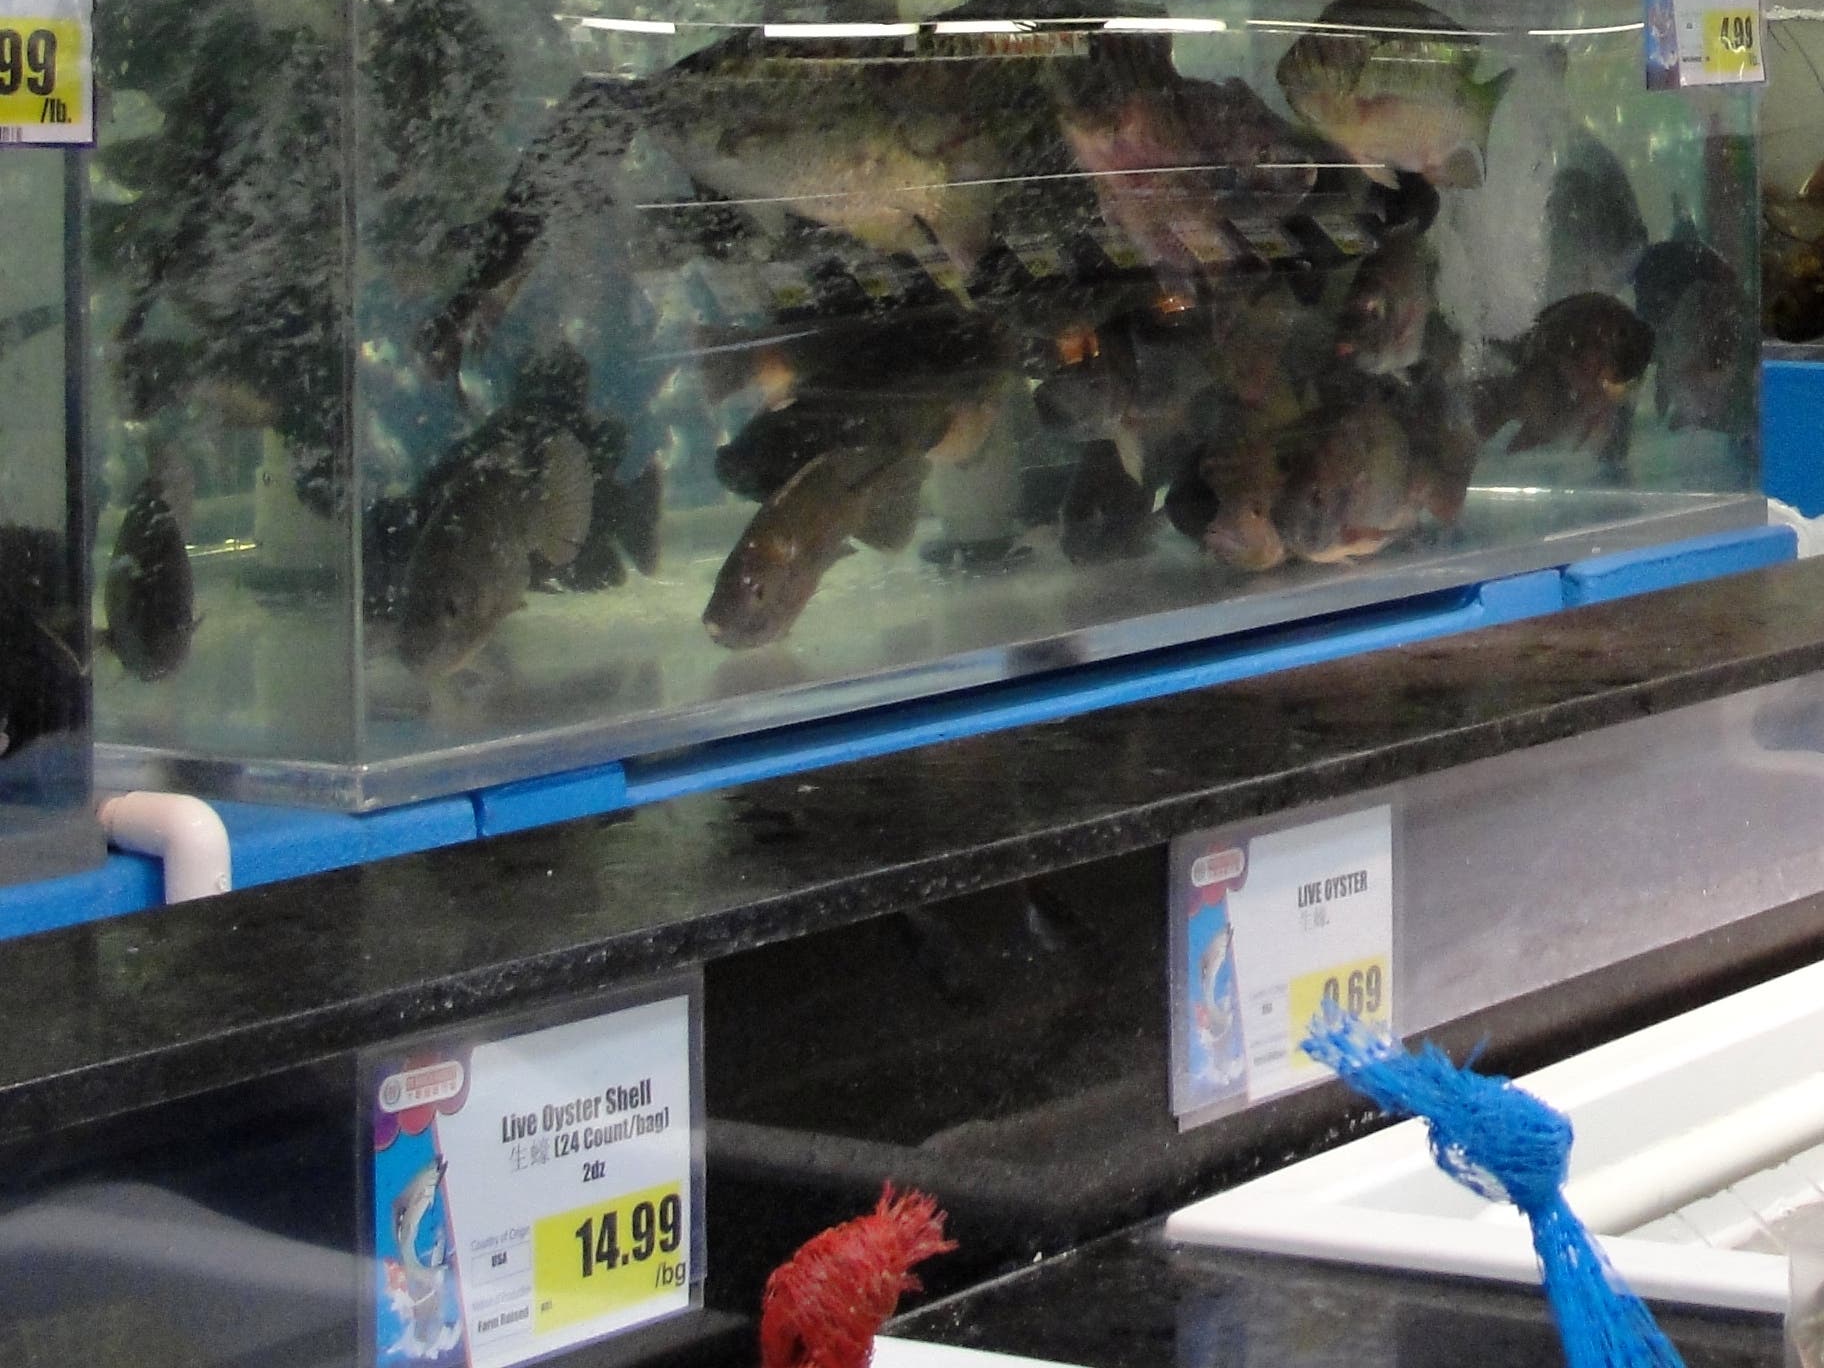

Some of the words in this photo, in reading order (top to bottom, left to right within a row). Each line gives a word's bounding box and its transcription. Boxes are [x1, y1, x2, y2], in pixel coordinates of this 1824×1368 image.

[40, 97, 72, 124] /lb.
[1297, 880, 1322, 908] LIVE
[1324, 870, 1368, 902] OYSTER
[501, 1112, 538, 1144] Live
[541, 1094, 603, 1134] Oyster
[604, 1077, 652, 1116] Shell
[582, 1159, 607, 1183] 2dz
[574, 1192, 683, 1278] 14.99
[654, 1259, 687, 1289] /bg
